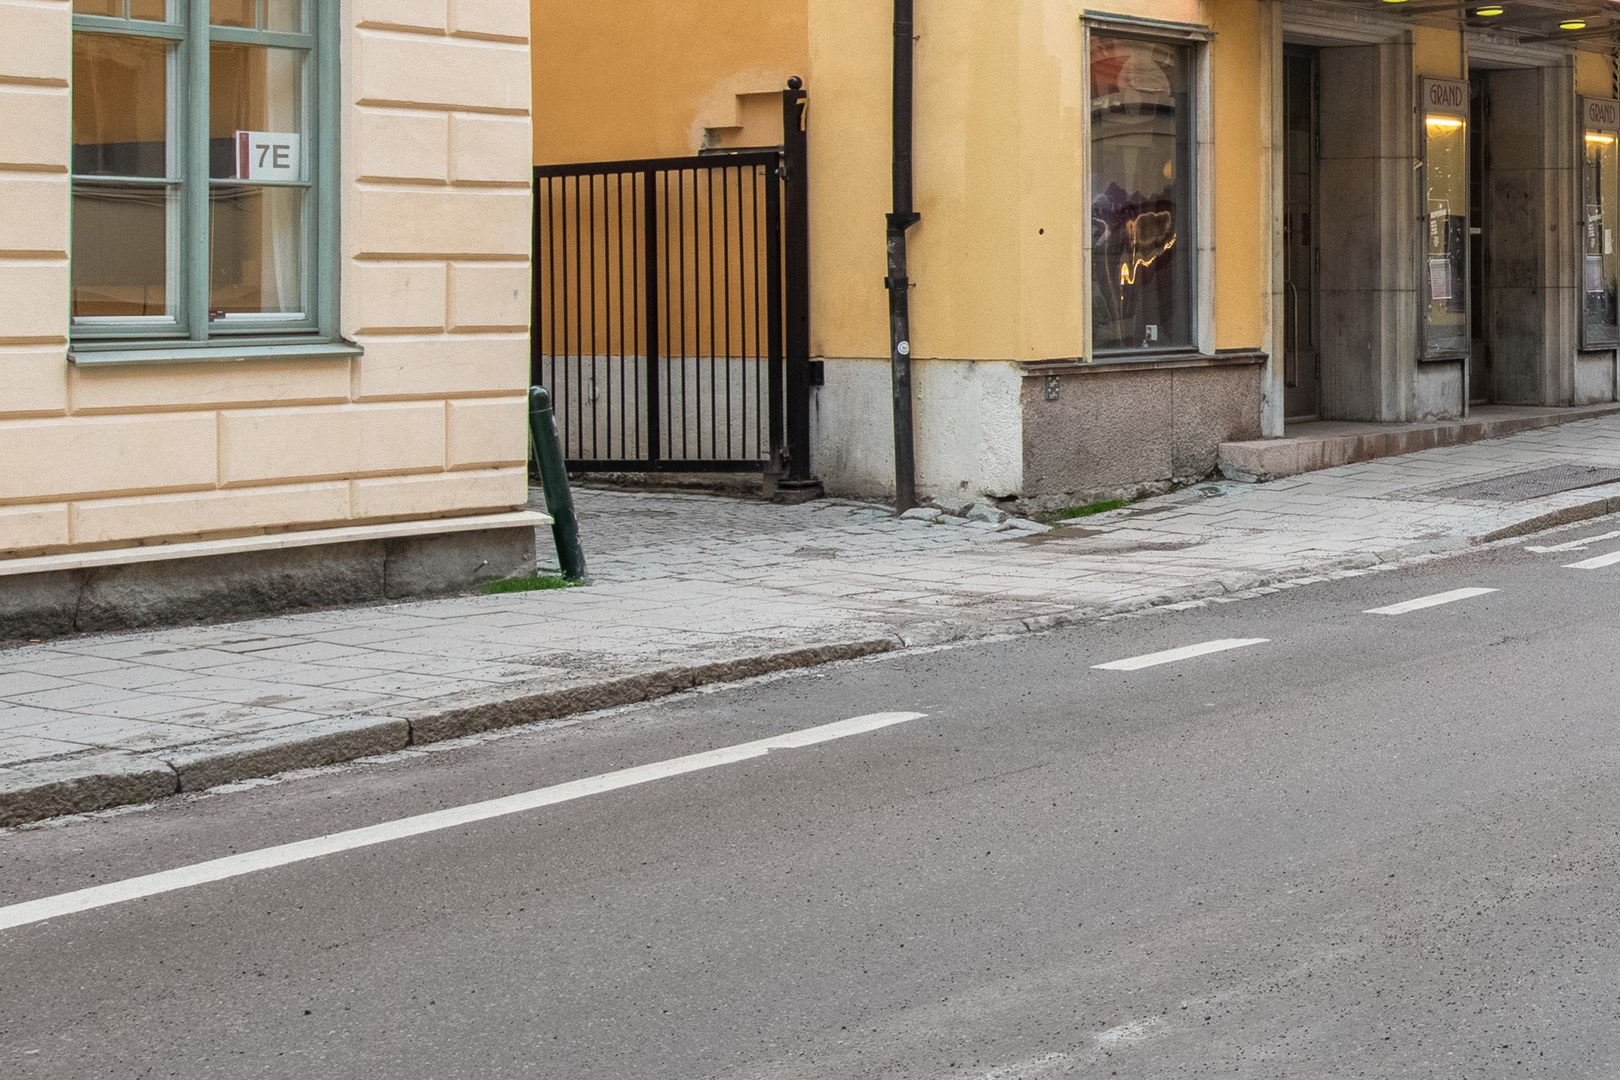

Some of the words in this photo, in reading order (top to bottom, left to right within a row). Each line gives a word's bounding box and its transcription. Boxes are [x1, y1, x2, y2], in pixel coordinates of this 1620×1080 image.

[1429, 84, 1463, 107] GRAND
[1588, 103, 1616, 124] GRAND
[255, 144, 290, 169] 7E
